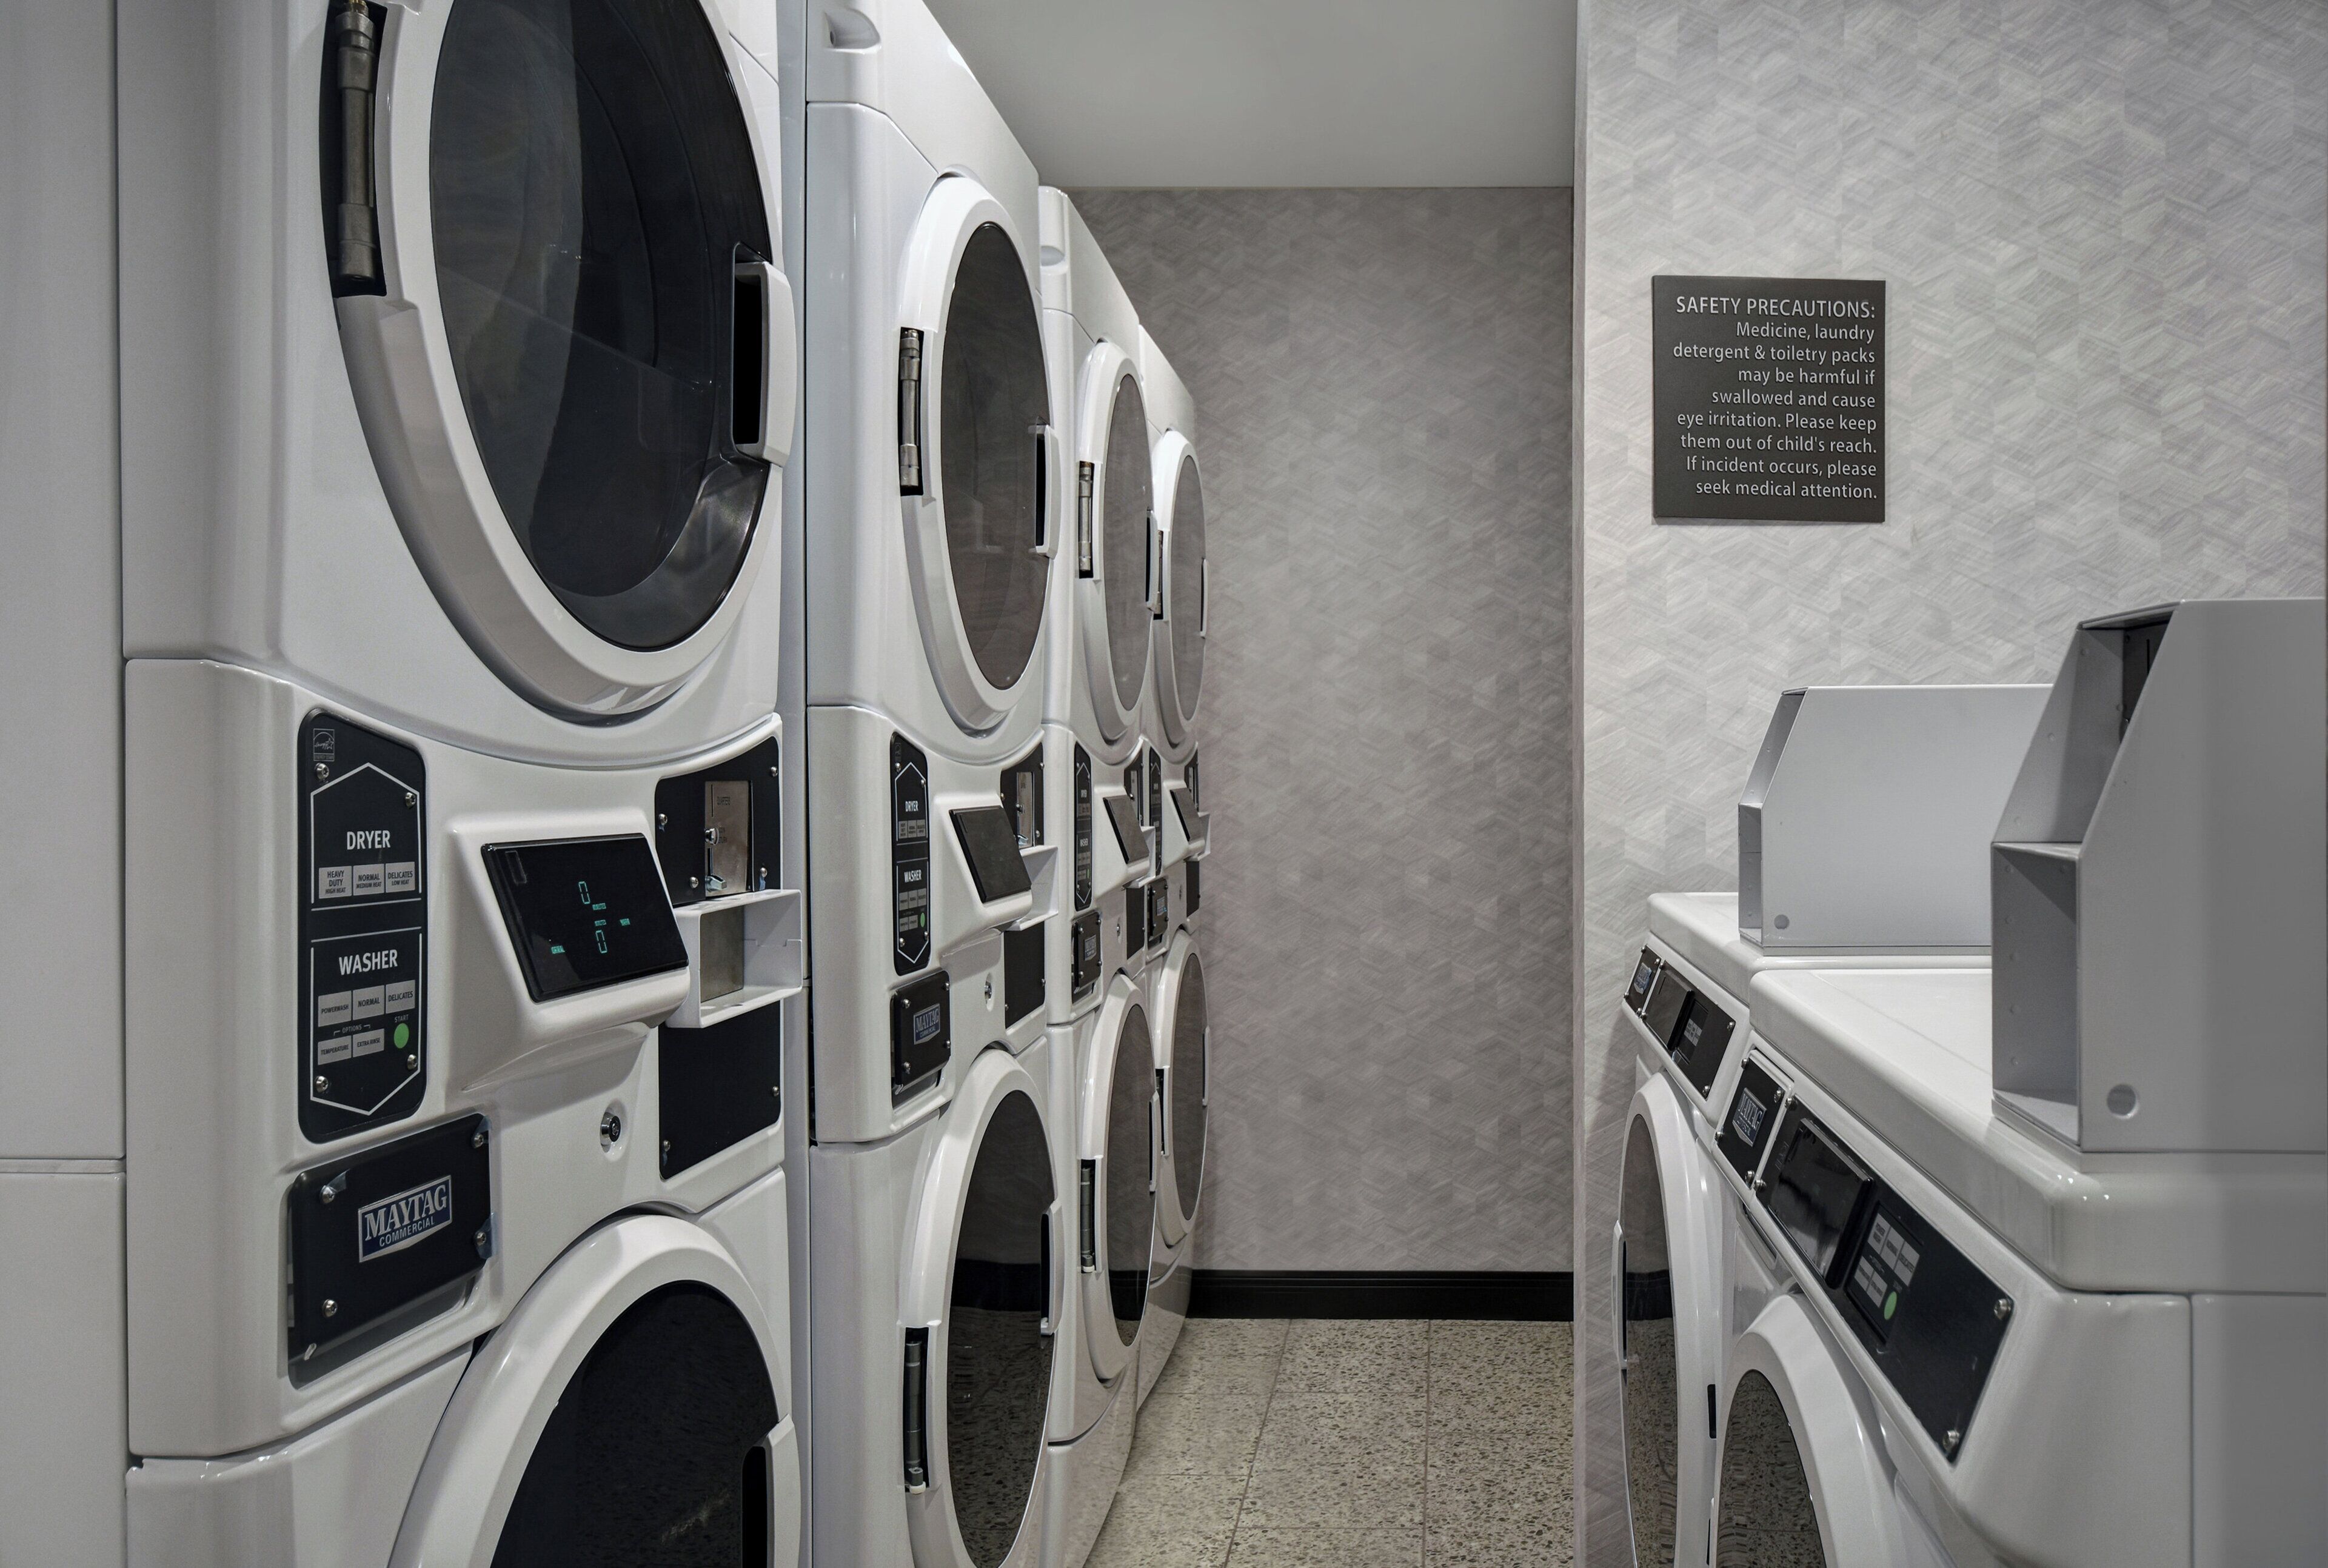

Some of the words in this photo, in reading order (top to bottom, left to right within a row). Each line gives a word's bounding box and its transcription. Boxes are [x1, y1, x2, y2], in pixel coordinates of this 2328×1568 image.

[1676, 296, 1741, 314] SAFETY
[1747, 299, 1875, 318] PRECAUTIONS:
[1736, 322, 1810, 340] Medicine,
[1815, 324, 1875, 344] laundry
[1673, 342, 1750, 362] detergent
[1755, 345, 1765, 359] &
[1770, 345, 1826, 365] toiletry
[1832, 347, 1875, 365] packs
[1738, 370, 1770, 385] may
[1776, 367, 1794, 382] be
[1799, 369, 1859, 384] harmful
[1865, 370, 1875, 385] if
[1712, 389, 1792, 405] swallowed
[1799, 392, 1826, 406] and
[1832, 394, 1875, 407] cause
[1677, 413, 1704, 429] eye
[1709, 412, 1781, 427] irritation.
[1785, 414, 1834, 429] Please
[1839, 415, 1876, 433] keep
[1681, 433, 1720, 449] them
[1726, 436, 1751, 450] out
[1757, 435, 1771, 450] of
[1777, 436, 1824, 452] child's
[1830, 439, 1876, 453] reach.
[1687, 456, 1696, 470] If
[1702, 456, 1763, 473] incident
[1770, 461, 1822, 477] occurs,
[1827, 460, 1876, 478] please
[1696, 479, 1730, 494] seek
[1736, 481, 1795, 496] medical
[1801, 484, 1877, 498] attention.
[346, 830, 391, 850] DRYER
[358, 873, 380, 882] NORMAL
[388, 870, 413, 879] DELICATES
[339, 949, 398, 976] WASHER
[358, 997, 380, 1007] NORMAL
[388, 991, 413, 1002] DELICATES
[321, 1004, 349, 1014] POWERWASH
[395, 1014, 409, 1023] START
[342, 1024, 362, 1033] OPTIONS
[916, 1008, 938, 1033] MAYTAG
[321, 1044, 349, 1055] TEMPERATURE
[364, 1184, 447, 1241] MAYTAG
[379, 1216, 435, 1247] COMMERCIAL
